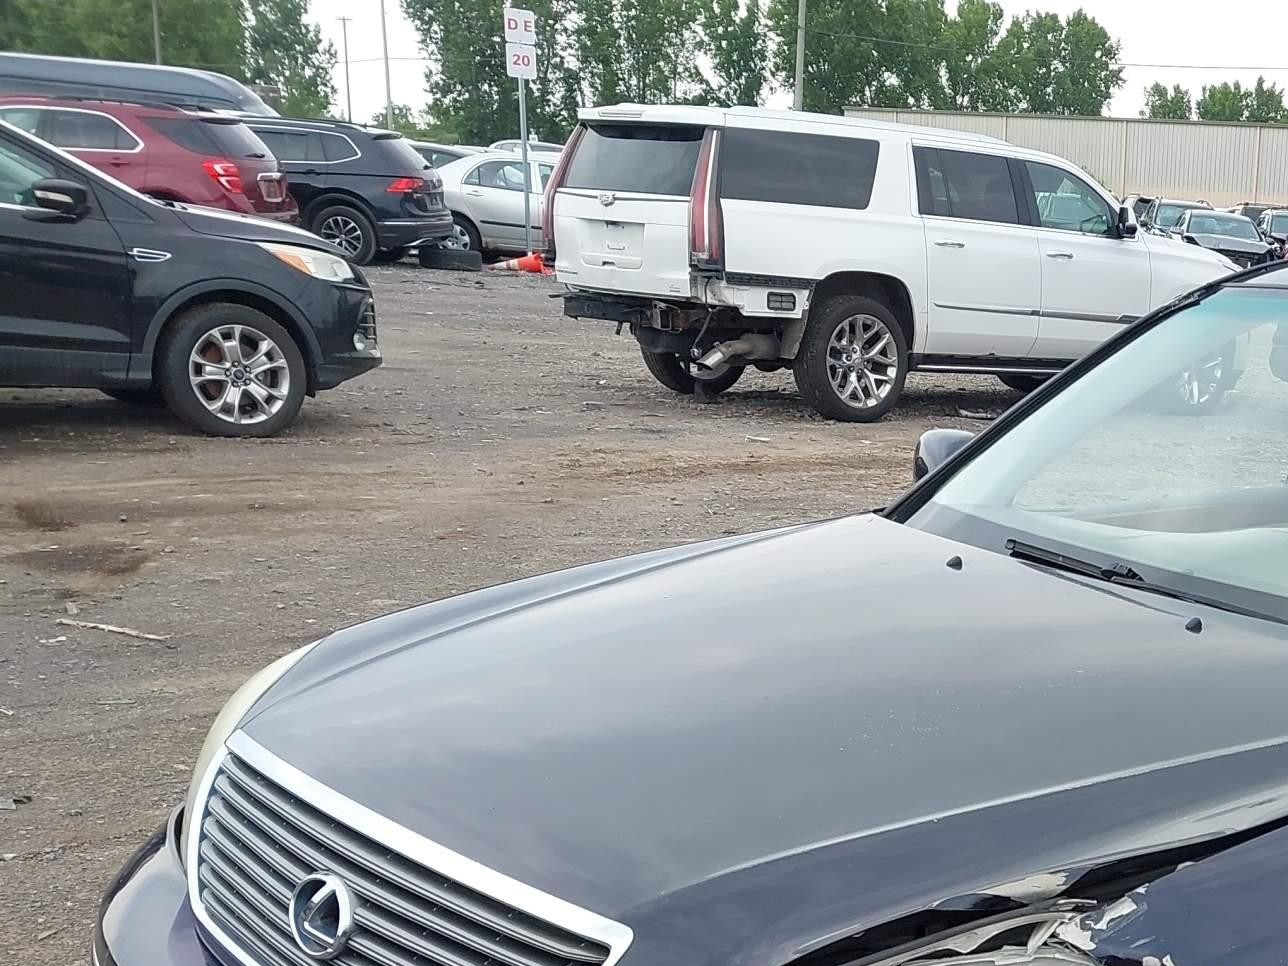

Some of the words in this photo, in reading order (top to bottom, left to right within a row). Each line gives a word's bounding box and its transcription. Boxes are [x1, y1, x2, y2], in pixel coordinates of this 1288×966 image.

[508, 18, 518, 30] D
[524, 21, 533, 32] E
[512, 54, 530, 66] 20
